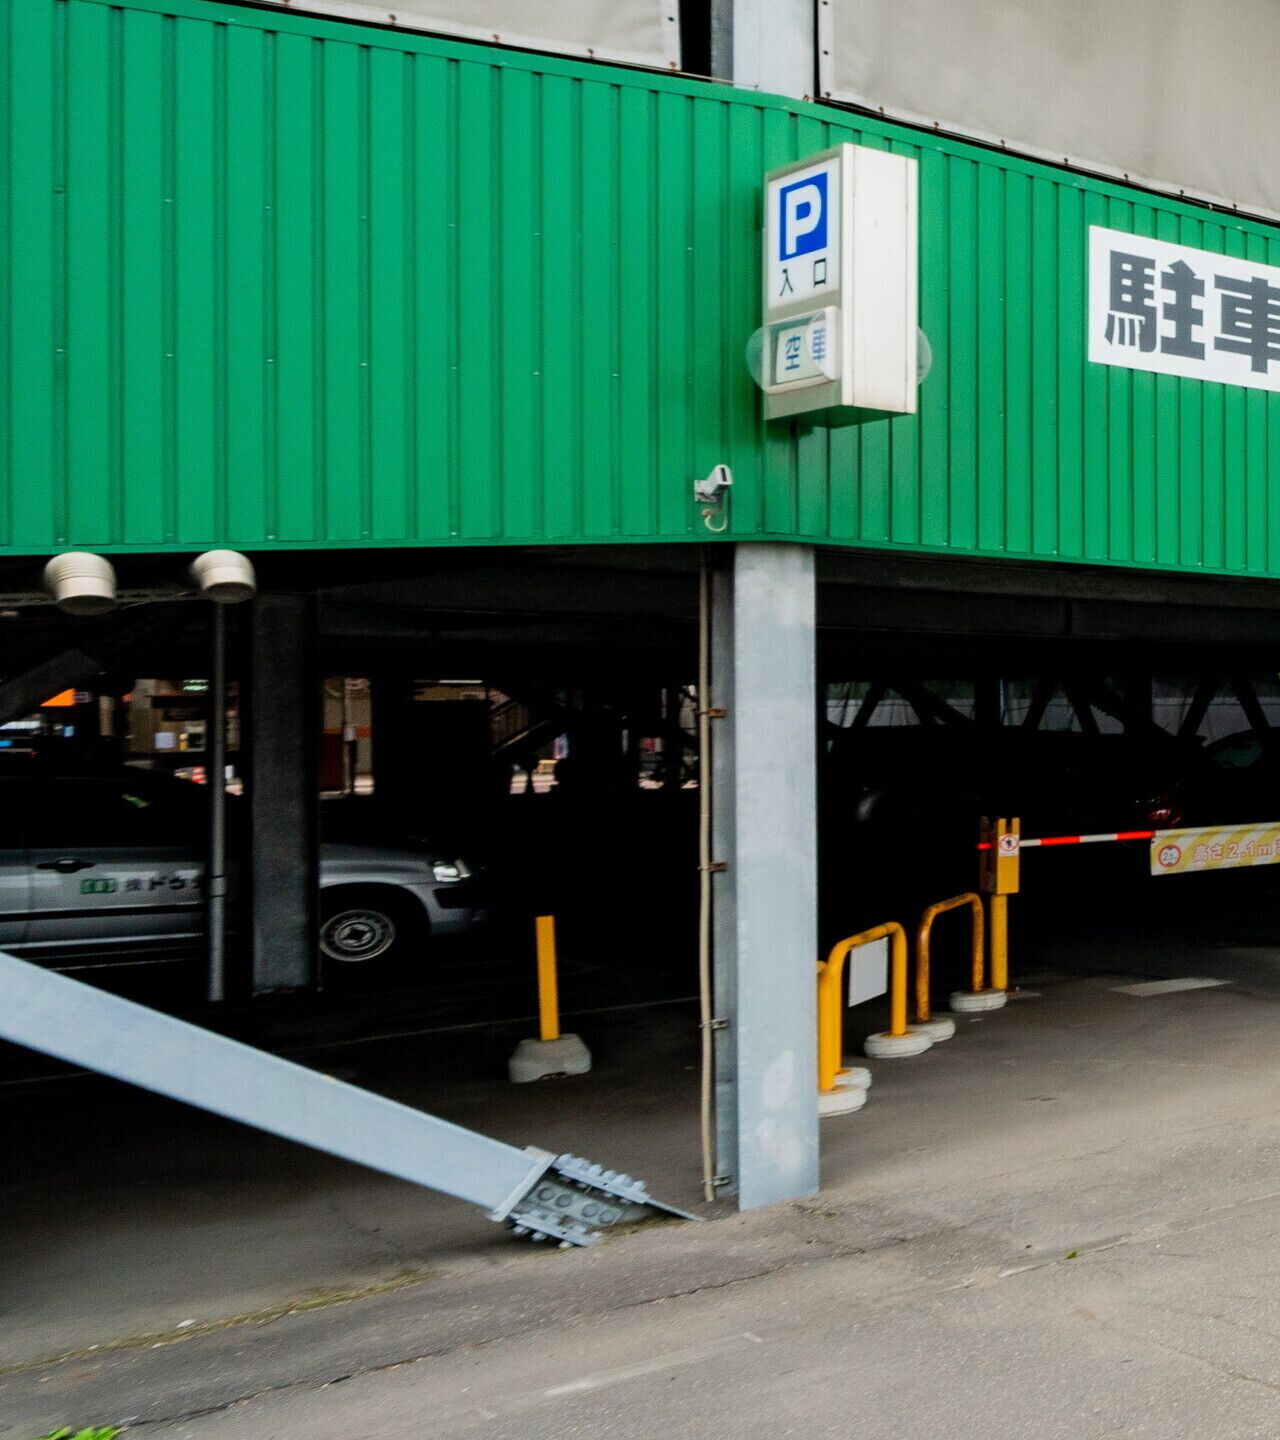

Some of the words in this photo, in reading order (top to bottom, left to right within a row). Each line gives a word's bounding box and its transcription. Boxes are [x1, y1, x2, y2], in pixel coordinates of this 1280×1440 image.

[785, 183, 822, 255] P
[778, 267, 828, 298] 入口
[784, 326, 826, 371] 空車
